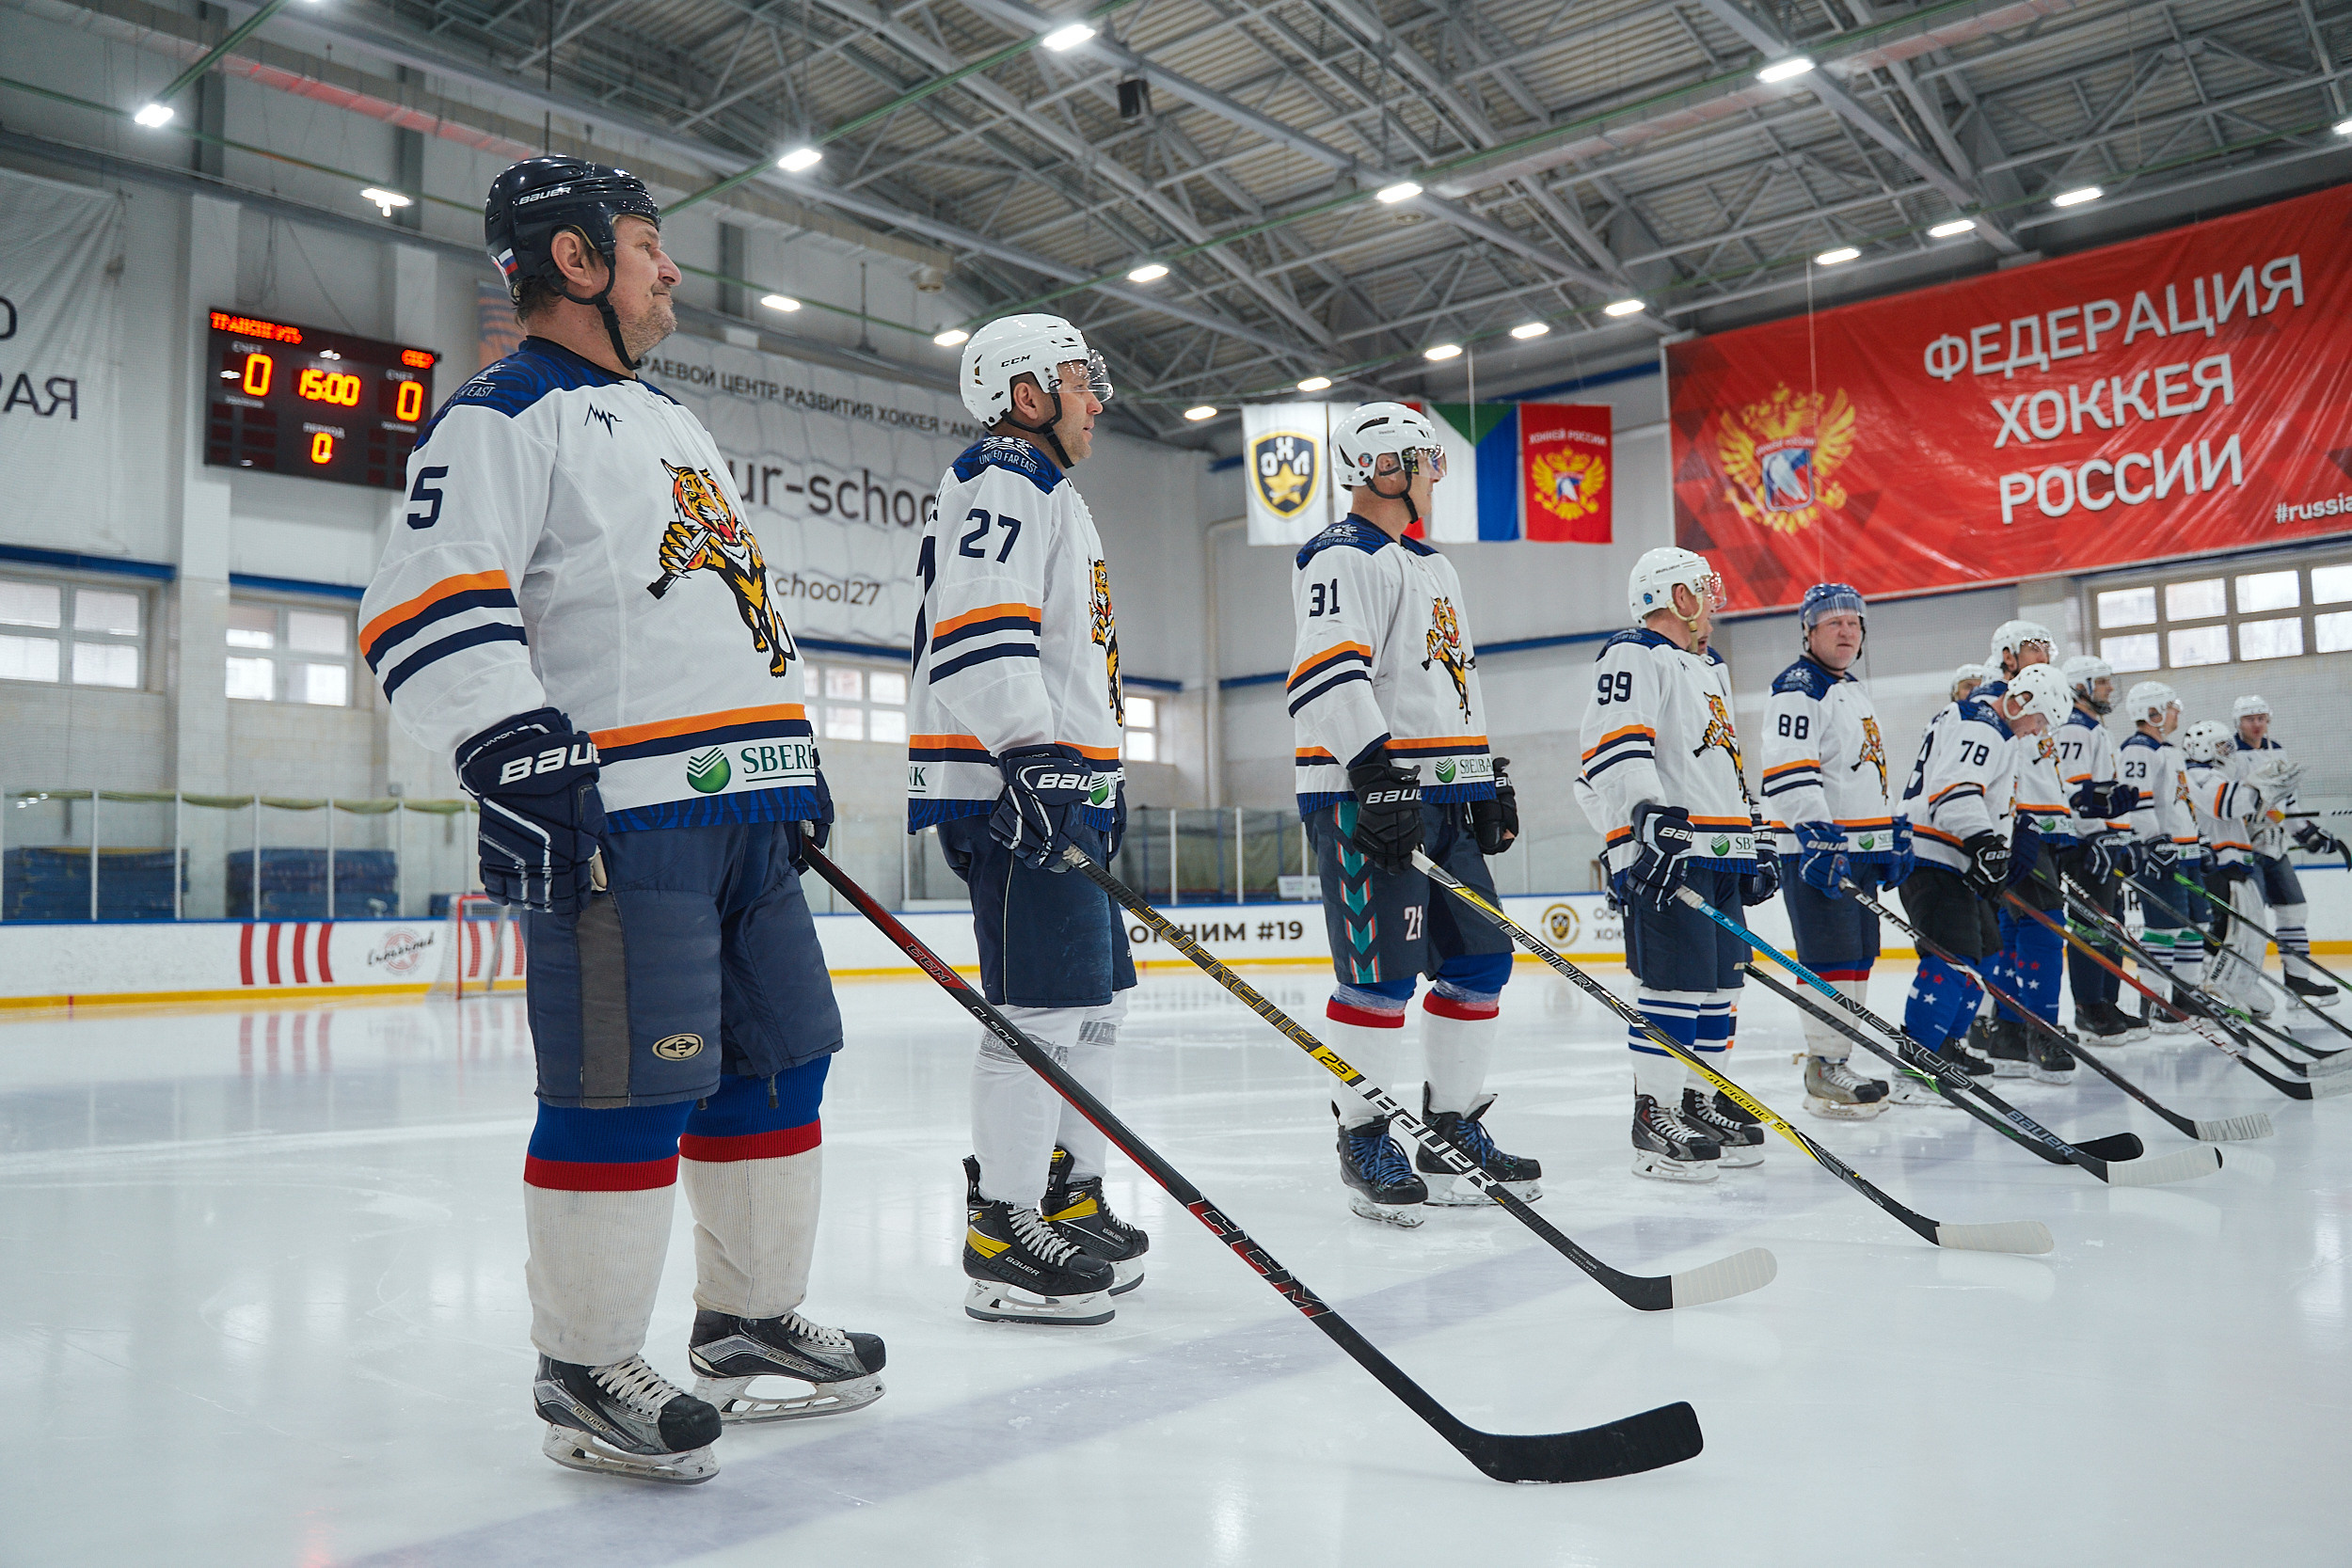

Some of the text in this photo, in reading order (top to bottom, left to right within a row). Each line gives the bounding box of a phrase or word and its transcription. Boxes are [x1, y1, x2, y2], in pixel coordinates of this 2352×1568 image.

[1923, 253, 2305, 382] ФЕДЕРАЦИЯ
[243, 353, 273, 397] 0
[1001, 355, 1031, 368] CCM
[298, 368, 361, 406] 15:00
[396, 380, 424, 421] 0
[722, 372, 780, 399] ЦЕНТР
[784, 386, 874, 420] РАЗВИТИЯ
[878, 406, 940, 433] ХОККЕЯ
[1991, 354, 2235, 450] ХОККЕЯ
[310, 432, 334, 464] 0
[1004, 452, 1019, 465] FAR
[407, 466, 449, 530] 5
[1998, 435, 2244, 524] РОССИИ
[959, 508, 1022, 563] 27
[1309, 578, 1340, 617] 31
[1597, 671, 1632, 705] 99
[483, 731, 516, 747] VAPOR
[1778, 714, 1809, 739] 88
[1960, 740, 1990, 767] 78
[2060, 742, 2083, 760] 77
[2125, 761, 2147, 778] 23
[1257, 921, 1303, 942] #19
[906, 942, 951, 983] CCM
[1834, 992, 1975, 1091] NEXUS
[1705, 1073, 1771, 1121] SUPREME
[1368, 1095, 1499, 1193] BAUER
[2006, 1110, 2075, 1158] BAUER
[1103, 1227, 1125, 1243] BAUER
[1005, 1256, 1041, 1276] BAUER
[1187, 1192, 1333, 1319] CCM
[770, 1354, 805, 1370] BAUER
[575, 1406, 608, 1432] BAUER
